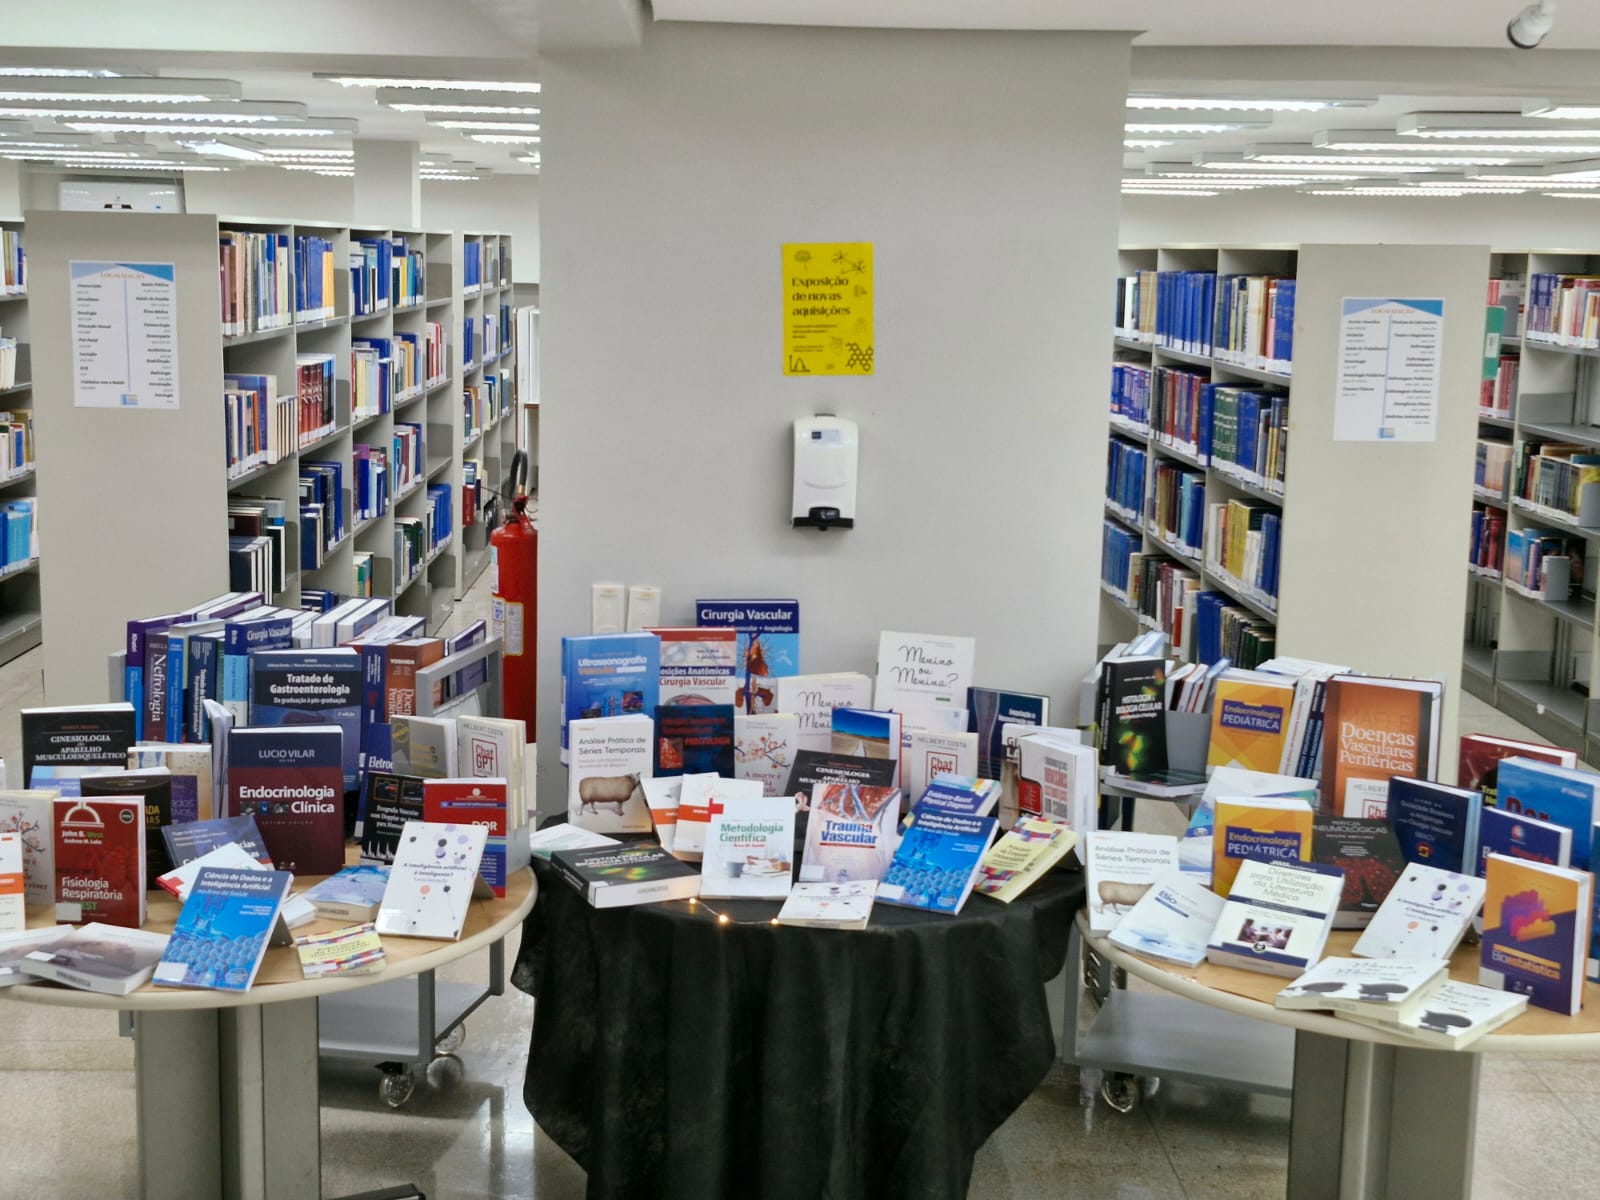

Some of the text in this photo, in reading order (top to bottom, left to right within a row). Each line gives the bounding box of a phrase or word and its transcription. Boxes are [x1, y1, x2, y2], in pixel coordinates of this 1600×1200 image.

[792, 276, 848, 288] Exposição
[792, 292, 842, 302] de novas
[792, 305, 851, 318] aquisições
[701, 609, 792, 622] Cirurgia Vascular
[247, 630, 268, 642] Cirurgia
[578, 656, 648, 667] Ultrassonografia
[899, 646, 954, 666] Menino
[890, 666, 959, 688] Menina?
[918, 668, 932, 676] ou
[286, 674, 334, 684] Tratado de
[659, 678, 726, 688] Cirurgia Vascular
[149, 654, 166, 722] Nefrologia
[270, 684, 350, 696] Gastroenterologia
[798, 691, 854, 708] Menino
[1224, 704, 1280, 720] Endocrinologia
[1222, 713, 1280, 730] PEDIÁTRICA
[50, 734, 111, 743] CINESIOLOGIA
[636, 736, 646, 744] de
[1341, 722, 1415, 746] Doenças
[259, 750, 316, 758] LUCIO VILAR
[475, 744, 494, 757] Chat
[578, 746, 646, 756] Séries Temporais
[1340, 738, 1414, 760] Vasculares
[36, 752, 126, 762] MUSCULOESQUELÉTICO
[476, 756, 494, 770] GPT
[931, 756, 953, 769] Chat
[1340, 750, 1413, 772] Periféricas
[240, 786, 335, 800] Endocrinologia
[291, 801, 335, 814] Clínica
[920, 813, 944, 822] Ciência
[720, 824, 784, 834] Metodologia
[825, 820, 872, 833] Trauma
[918, 820, 980, 832] Inteligência Artificial
[720, 833, 766, 842] Científica
[821, 831, 878, 844] Vascular
[1229, 832, 1298, 847] Endocrinologia
[1095, 845, 1125, 854] Análise
[1126, 846, 1158, 855] Prática
[1228, 842, 1298, 859] PEDIÁTRICA
[1095, 853, 1172, 866] Séries Temporais
[204, 872, 230, 880] Ciência
[240, 874, 262, 882] Dados
[1268, 867, 1312, 881] Diretrizes
[62, 877, 109, 889] Fisiologia
[201, 880, 272, 890] Inteligência Artificial
[1270, 882, 1314, 896] Literatura
[1277, 876, 1324, 891] Utilização
[62, 888, 122, 900] Respiratória
[1264, 888, 1298, 900] Médica
[80, 902, 98, 910] EST
